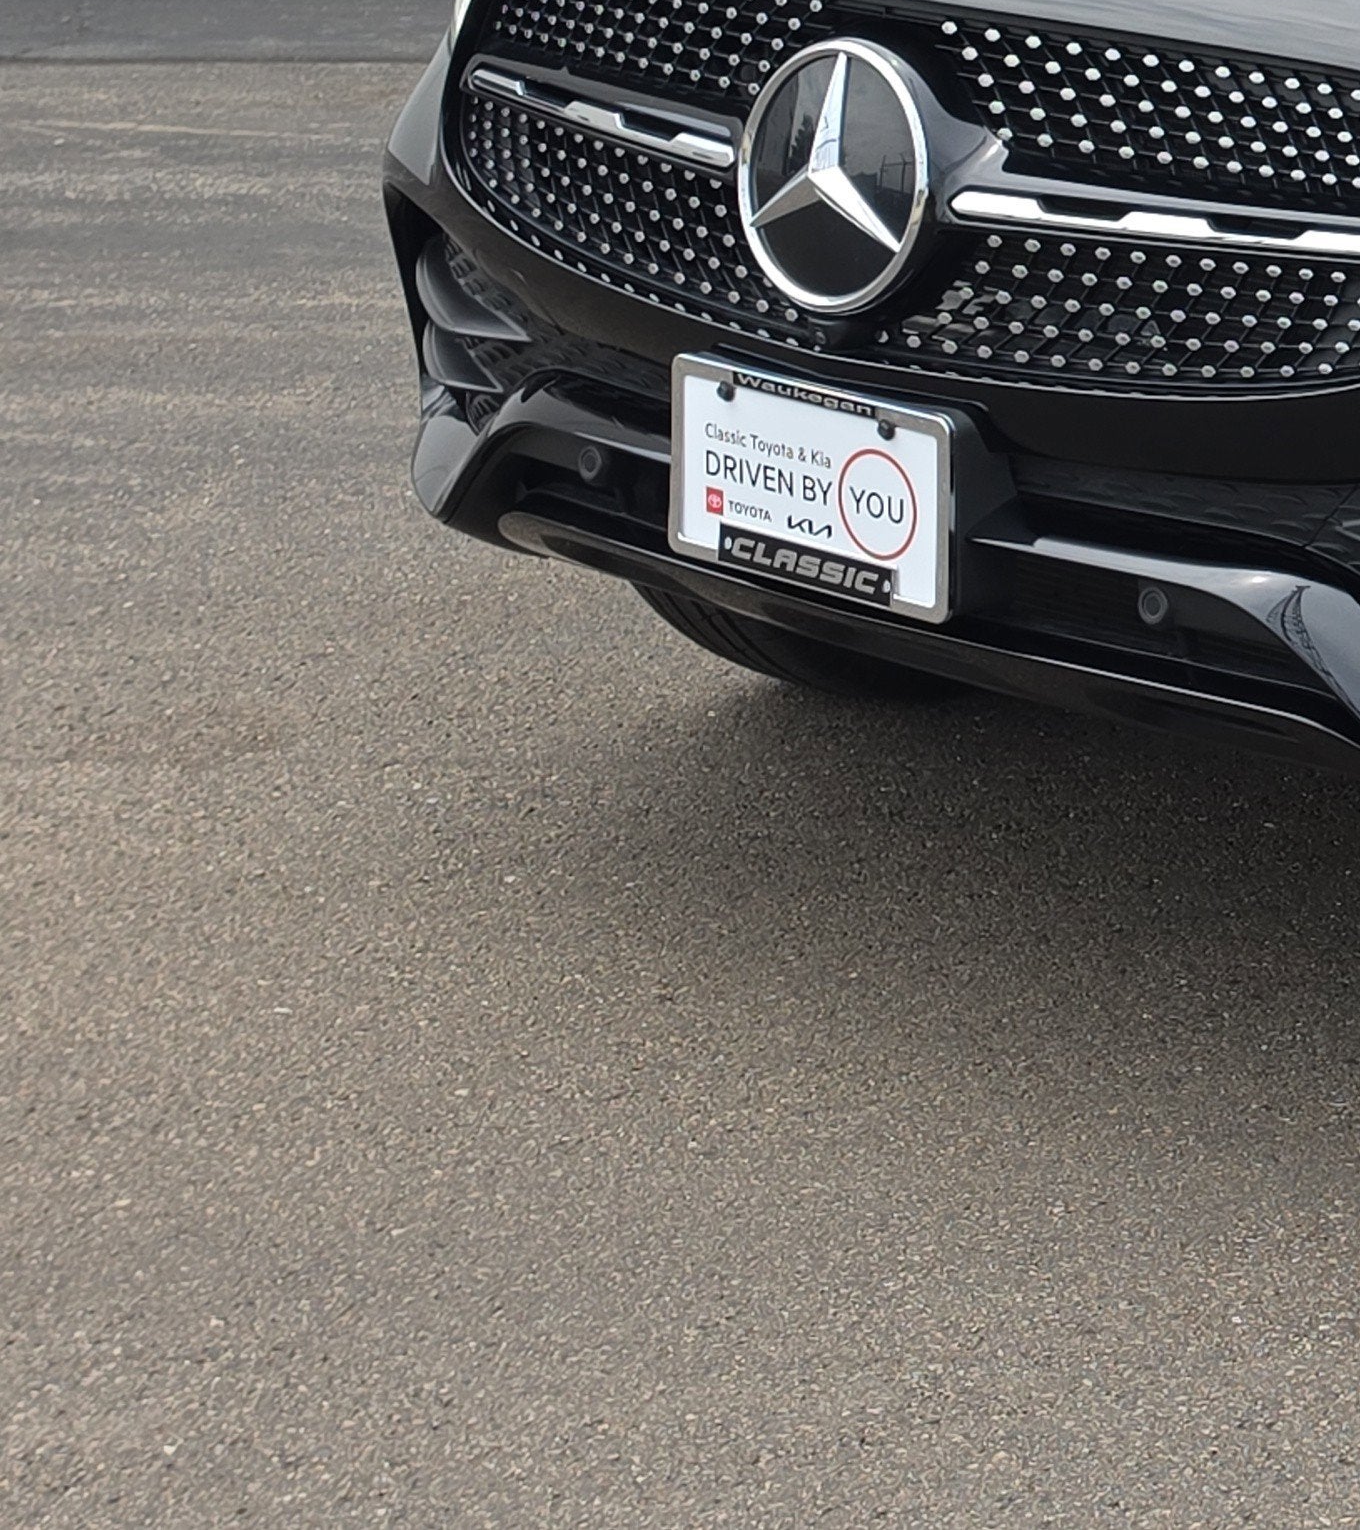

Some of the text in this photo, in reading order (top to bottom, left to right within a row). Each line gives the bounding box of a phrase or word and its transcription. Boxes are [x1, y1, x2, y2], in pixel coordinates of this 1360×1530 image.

[737, 372, 872, 416] Waukegan
[705, 422, 831, 469] Classic Toyota & Kia
[705, 450, 832, 506] DRIVEN BY
[728, 500, 772, 522] TOYOTA
[850, 485, 904, 524] YOU
[730, 537, 880, 594] CLASSIC
